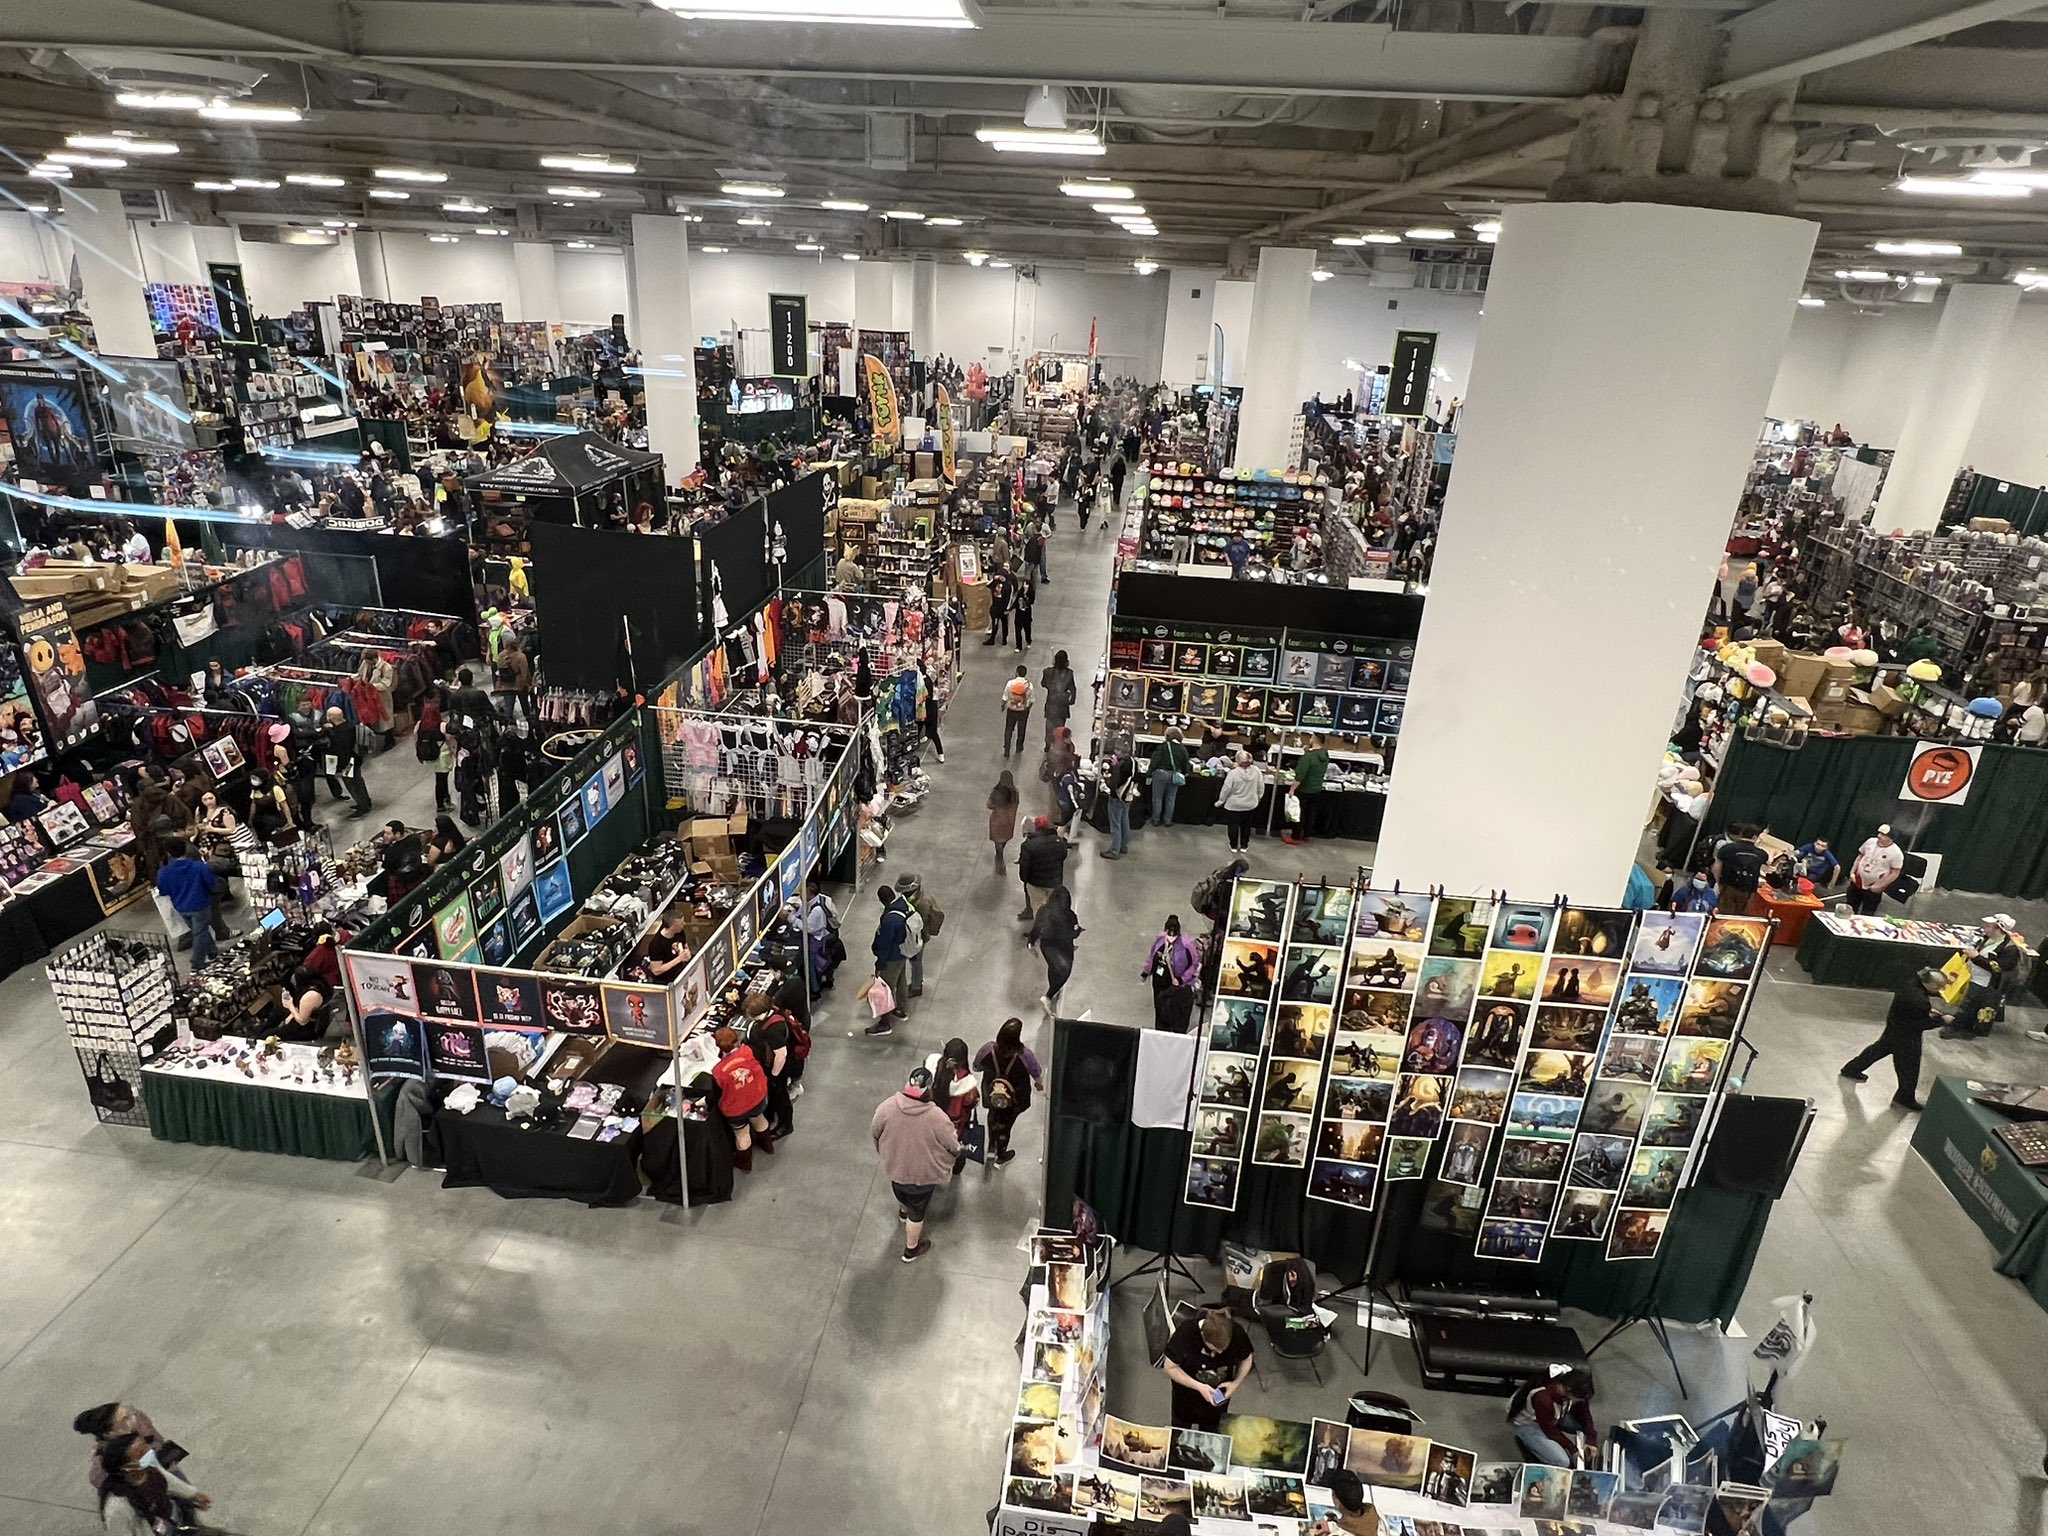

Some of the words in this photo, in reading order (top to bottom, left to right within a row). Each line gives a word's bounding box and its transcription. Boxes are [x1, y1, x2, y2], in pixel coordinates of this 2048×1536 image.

[226, 279, 241, 334] 11000
[786, 311, 794, 367] 11200
[872, 371, 892, 428] TOYNK
[1402, 347, 1418, 406] 11400
[46, 601, 63, 616] AND
[1922, 769, 1955, 785] PYE
